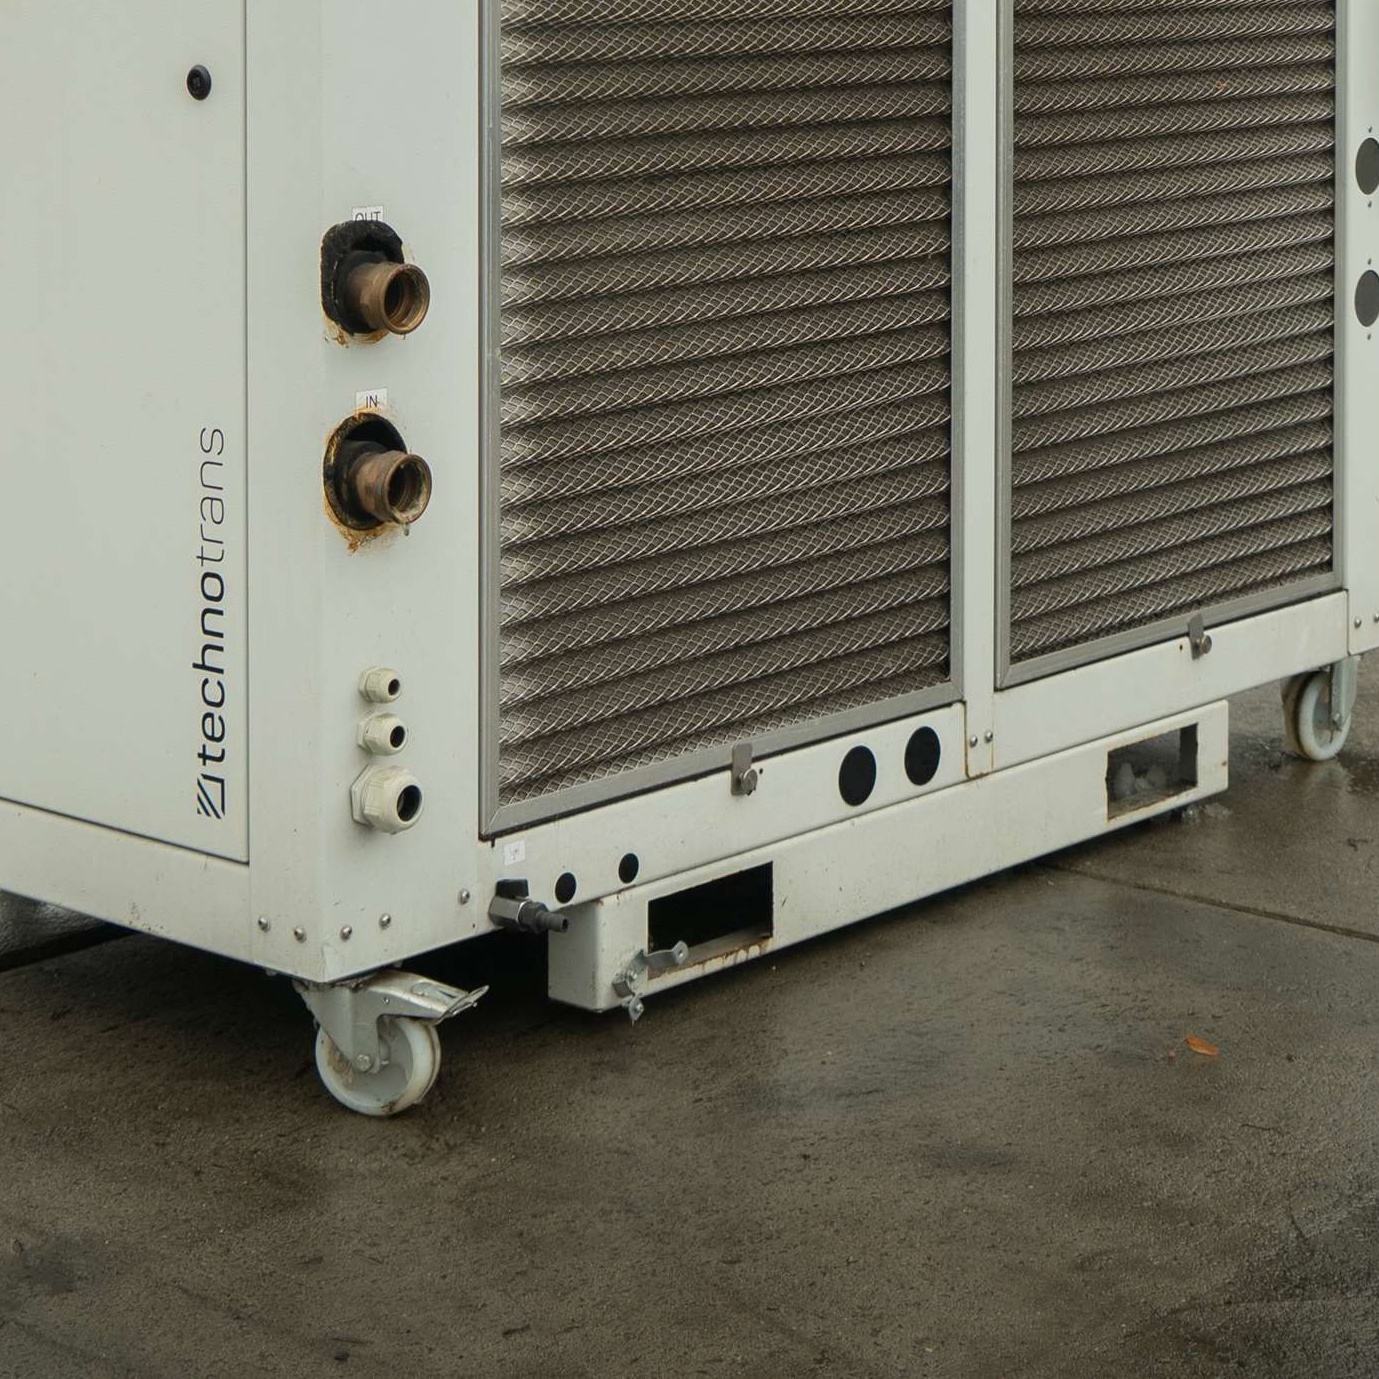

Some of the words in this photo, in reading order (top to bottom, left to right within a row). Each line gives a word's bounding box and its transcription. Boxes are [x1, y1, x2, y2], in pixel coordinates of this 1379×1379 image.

[355, 211, 381, 221] OUT
[365, 395, 378, 408] IN
[192, 427, 225, 766] technotrans
